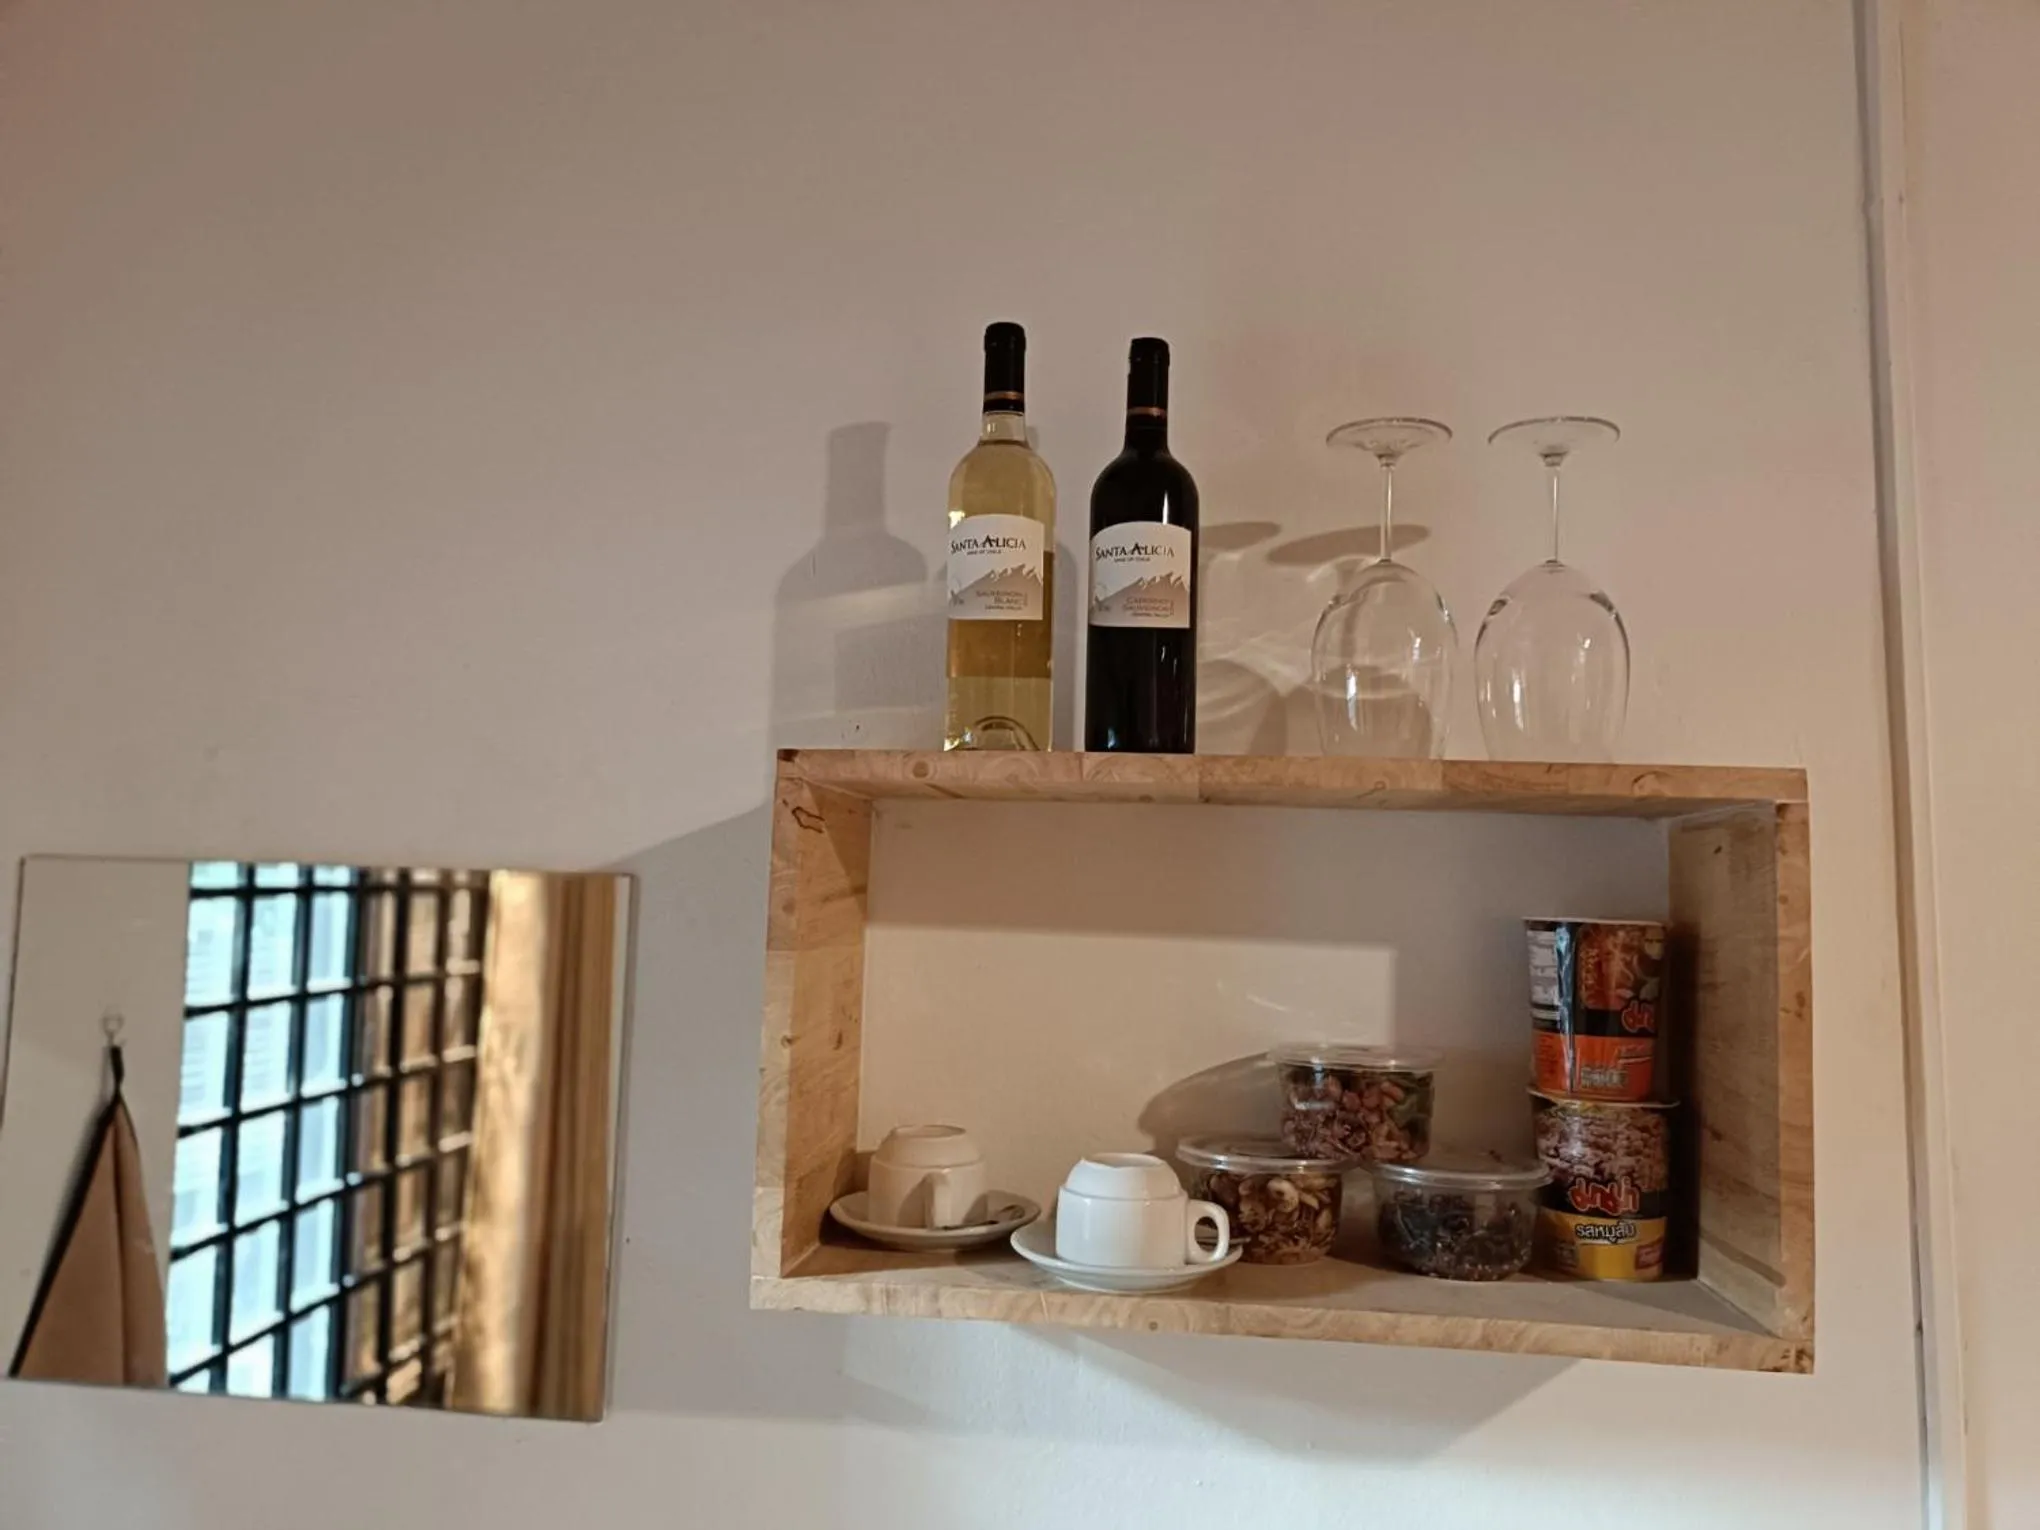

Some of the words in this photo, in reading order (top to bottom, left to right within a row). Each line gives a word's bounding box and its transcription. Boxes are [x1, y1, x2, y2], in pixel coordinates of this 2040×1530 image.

[950, 538, 979, 555] SANTA
[981, 534, 1026, 550] ALICIA
[1095, 545, 1127, 561] SANTA
[1130, 542, 1175, 557] ALICIA
[1568, 1175, 1640, 1216] มาม่า
